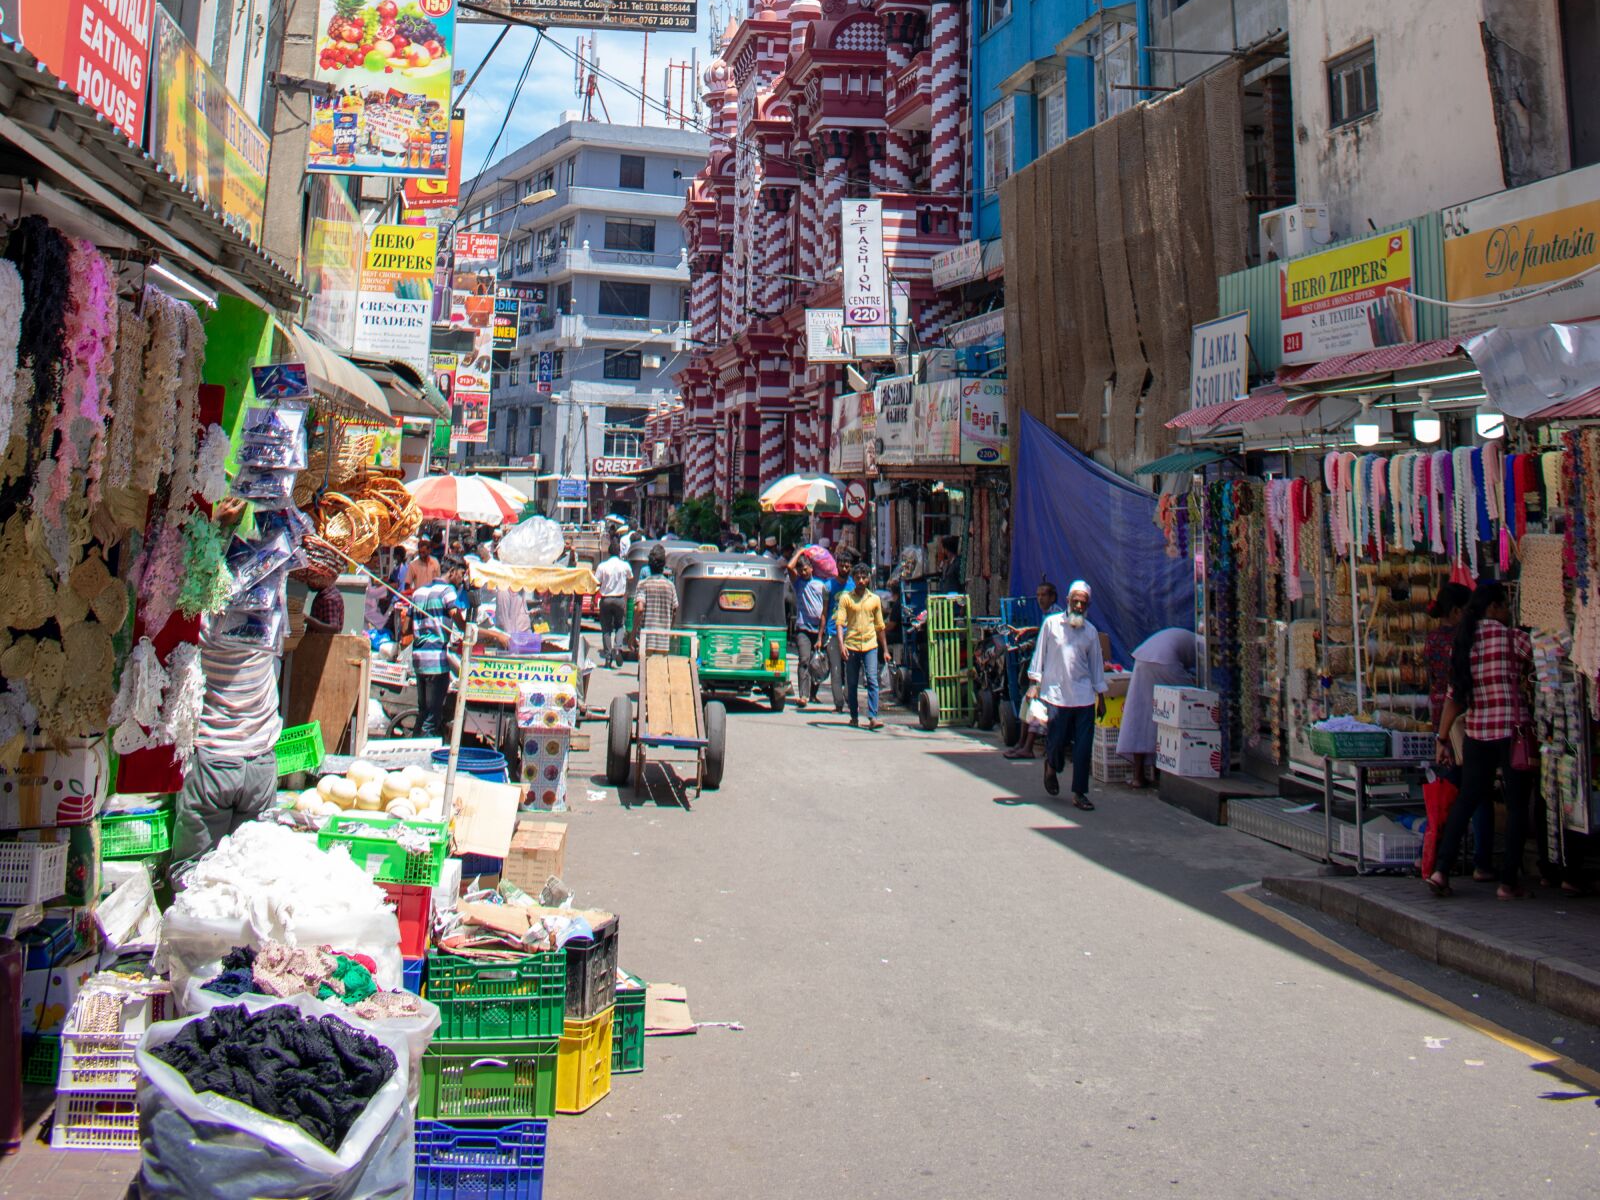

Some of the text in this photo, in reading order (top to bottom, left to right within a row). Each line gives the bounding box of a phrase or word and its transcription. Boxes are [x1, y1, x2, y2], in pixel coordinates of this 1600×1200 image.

[631, 1, 644, 11] Tel:
[645, 2, 658, 12] 011
[659, 3, 691, 13] 4856444
[602, 14, 617, 24] Hot
[639, 16, 657, 26] 0767
[659, 17, 673, 26] 160
[675, 17, 689, 27] 160
[80, 4, 142, 91] EATING
[76, 56, 137, 136] HOUSE
[374, 232, 415, 251] HERO
[470, 235, 497, 246] Fashion
[471, 245, 495, 254] Fusion
[372, 253, 433, 271] ZIPPERS
[857, 226, 871, 292] FASHION
[1513, 226, 1596, 288] fantasia
[363, 270, 379, 278] BEST
[1291, 258, 1388, 302] HERO ZIPPERS
[848, 295, 881, 306] CENTRE
[360, 301, 429, 315] CRESCENT
[853, 308, 878, 321] 220
[1329, 304, 1365, 325] TEXTILES
[363, 314, 424, 328] TRADERS
[1286, 334, 1300, 351] 214
[1201, 331, 1237, 369] LANKA
[1195, 367, 1241, 409] SEQUINS
[595, 459, 638, 473] CREST
[483, 661, 555, 673] Niyas Family
[468, 669, 569, 683] ACHCHARU
